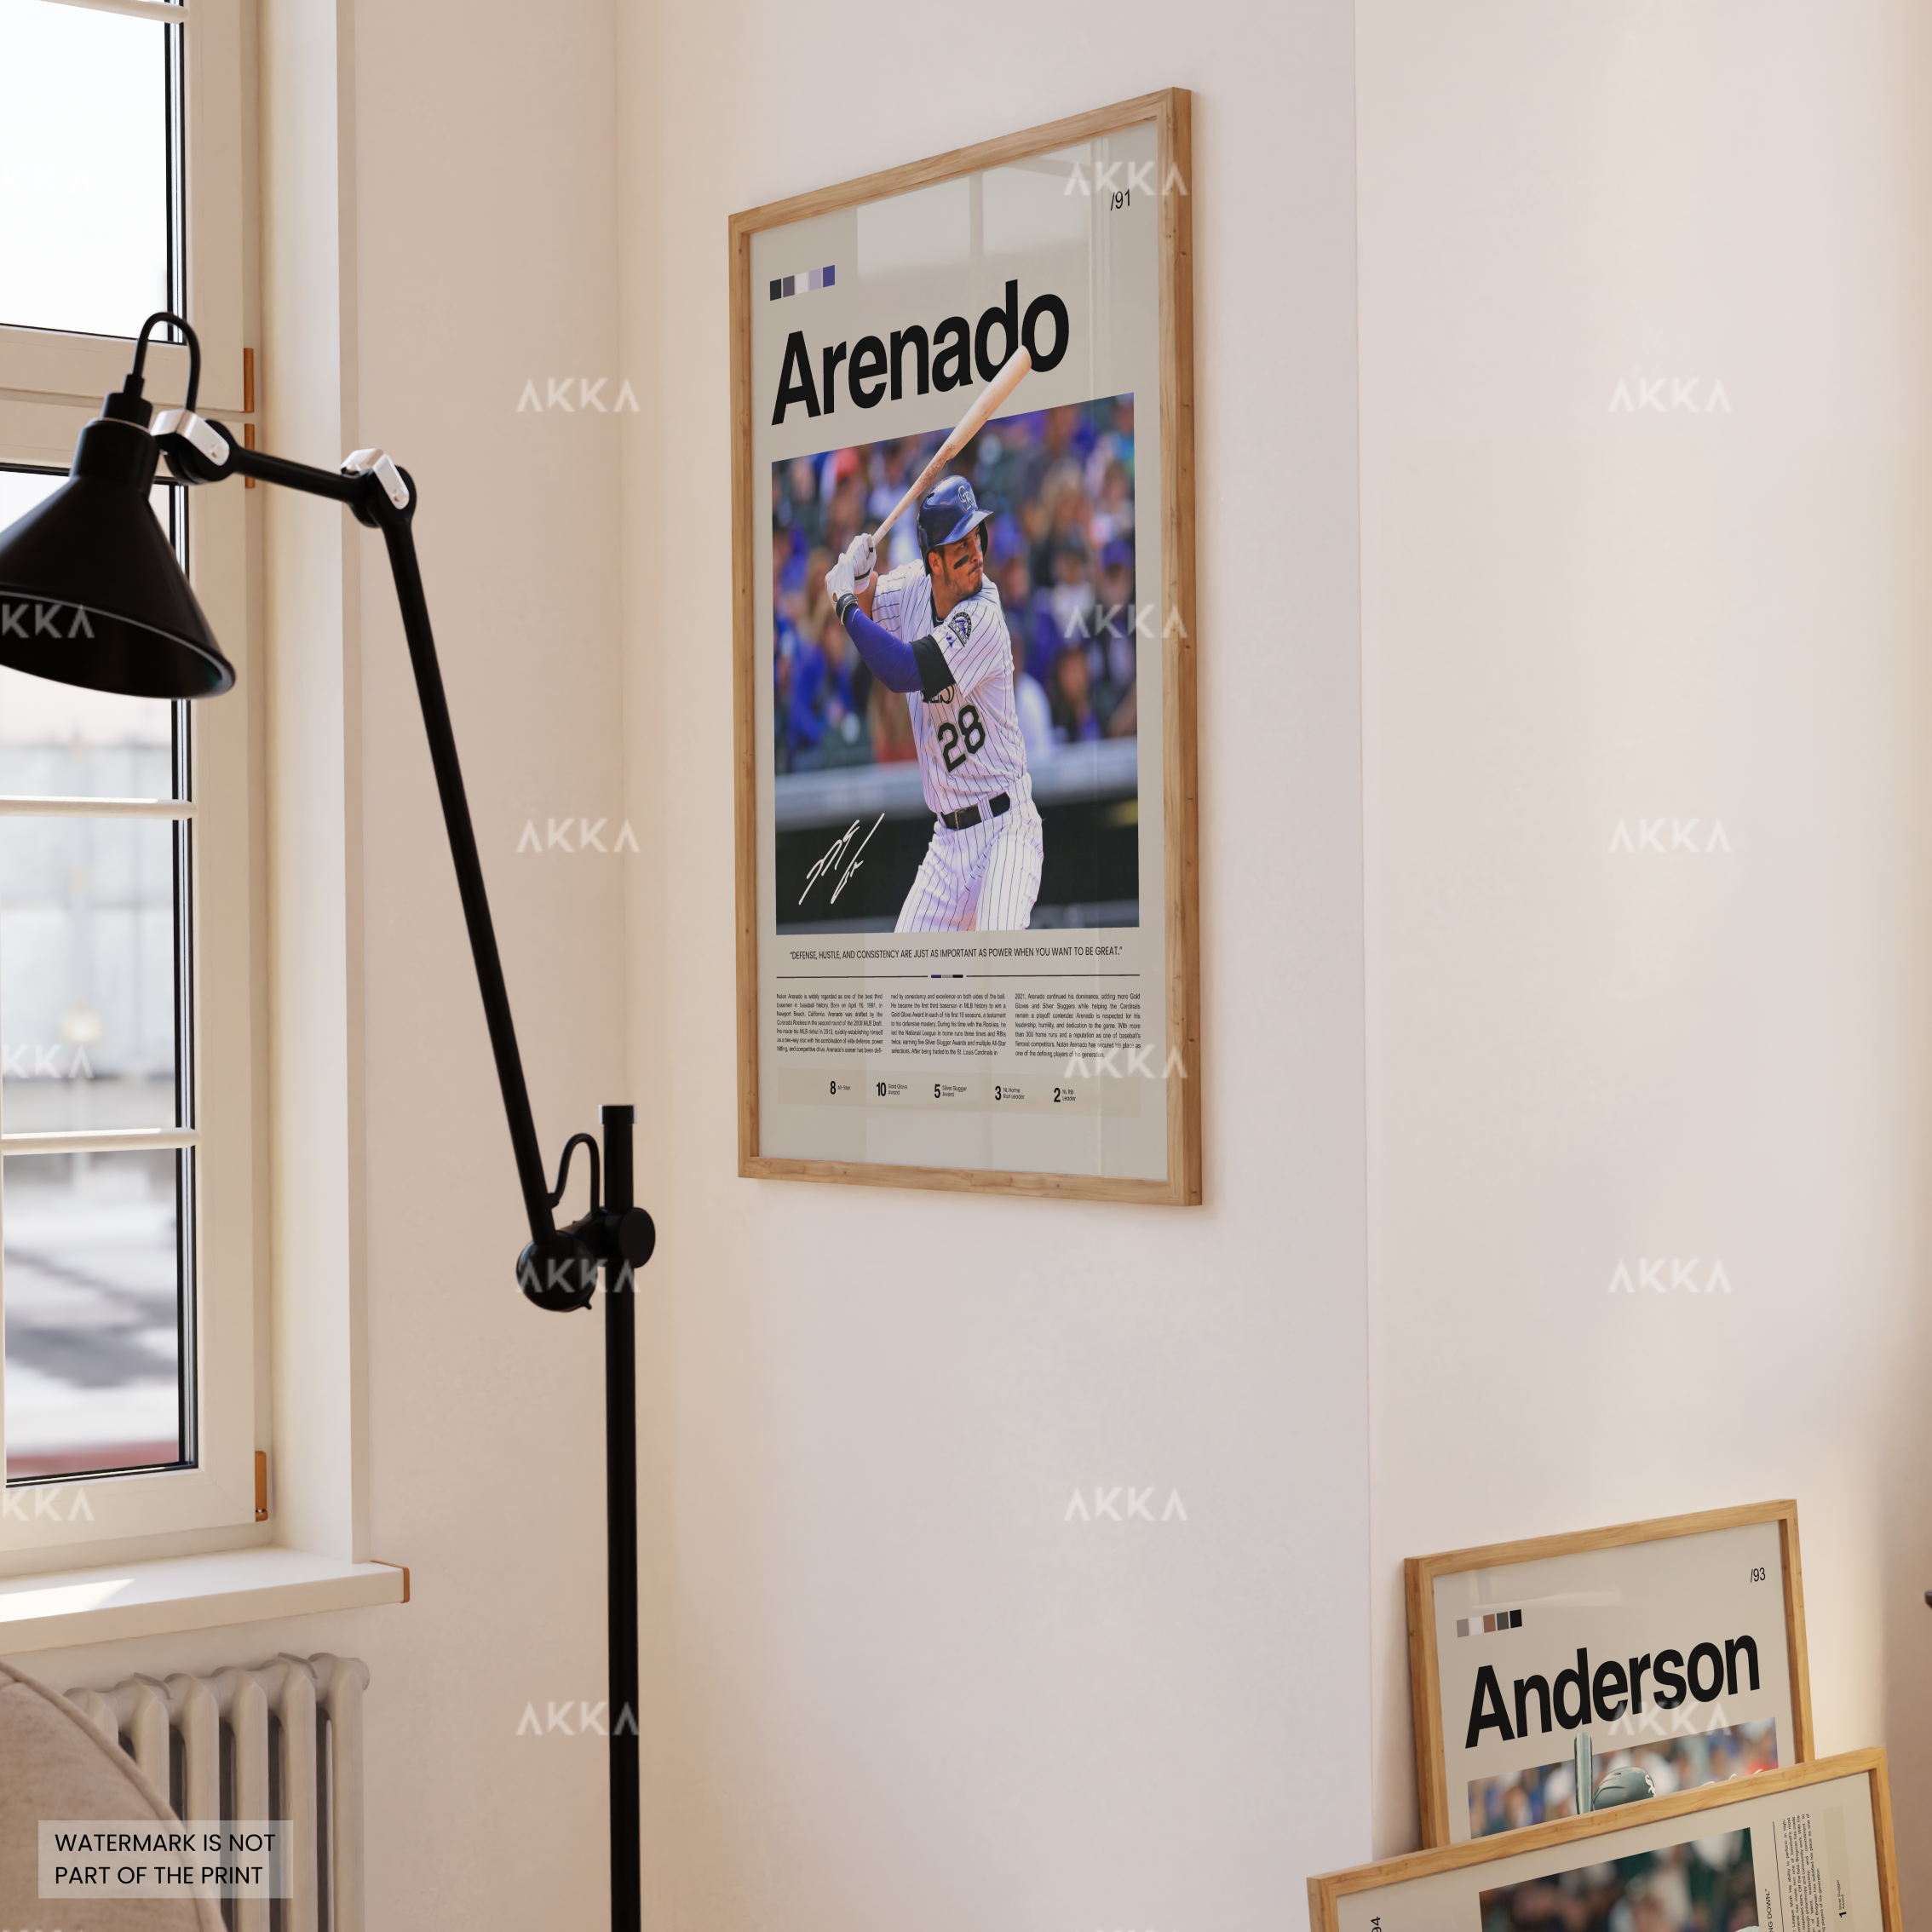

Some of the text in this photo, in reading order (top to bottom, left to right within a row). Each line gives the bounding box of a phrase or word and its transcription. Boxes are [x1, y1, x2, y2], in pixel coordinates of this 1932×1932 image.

[1110, 188, 1131, 211] /91
[771, 279, 1070, 426] Arenado
[937, 703, 986, 773] 28
[819, 950, 842, 961] HUSTLE,
[842, 950, 856, 959] AND
[856, 949, 900, 959] CONSISTENCY
[900, 949, 912, 958] ARE
[913, 949, 929, 958] JUST
[930, 948, 940, 958] AS
[940, 948, 978, 958] IMPORTANT
[978, 947, 989, 957] AS
[988, 947, 1013, 957] POWER
[1014, 947, 1034, 957] WHEN
[1035, 946, 1050, 957] YOU
[1051, 946, 1072, 957] WANT
[1074, 946, 1084, 957] TO
[1084, 946, 1094, 956] BE
[1101, 992, 1116, 1001] adding
[1056, 1002, 1076, 1010] Sluggers
[1091, 1003, 1107, 1011] helping
[1036, 1012, 1051, 1021] playoff
[1101, 1012, 1124, 1021] respected
[1122, 1041, 1135, 1049] place
[1135, 1041, 1141, 1049] as
[1037, 1049, 1053, 1058] defining
[1053, 1050, 1069, 1059] players
[1068, 1049, 1074, 1058] of
[830, 1080, 837, 1095] 8
[876, 1082, 887, 1097] 10
[934, 1084, 941, 1099] 5
[994, 1085, 1002, 1101] 3
[1053, 1087, 1061, 1103] 2
[1750, 1566, 1766, 1584] /93
[1465, 1634, 1761, 1750] Anderson
